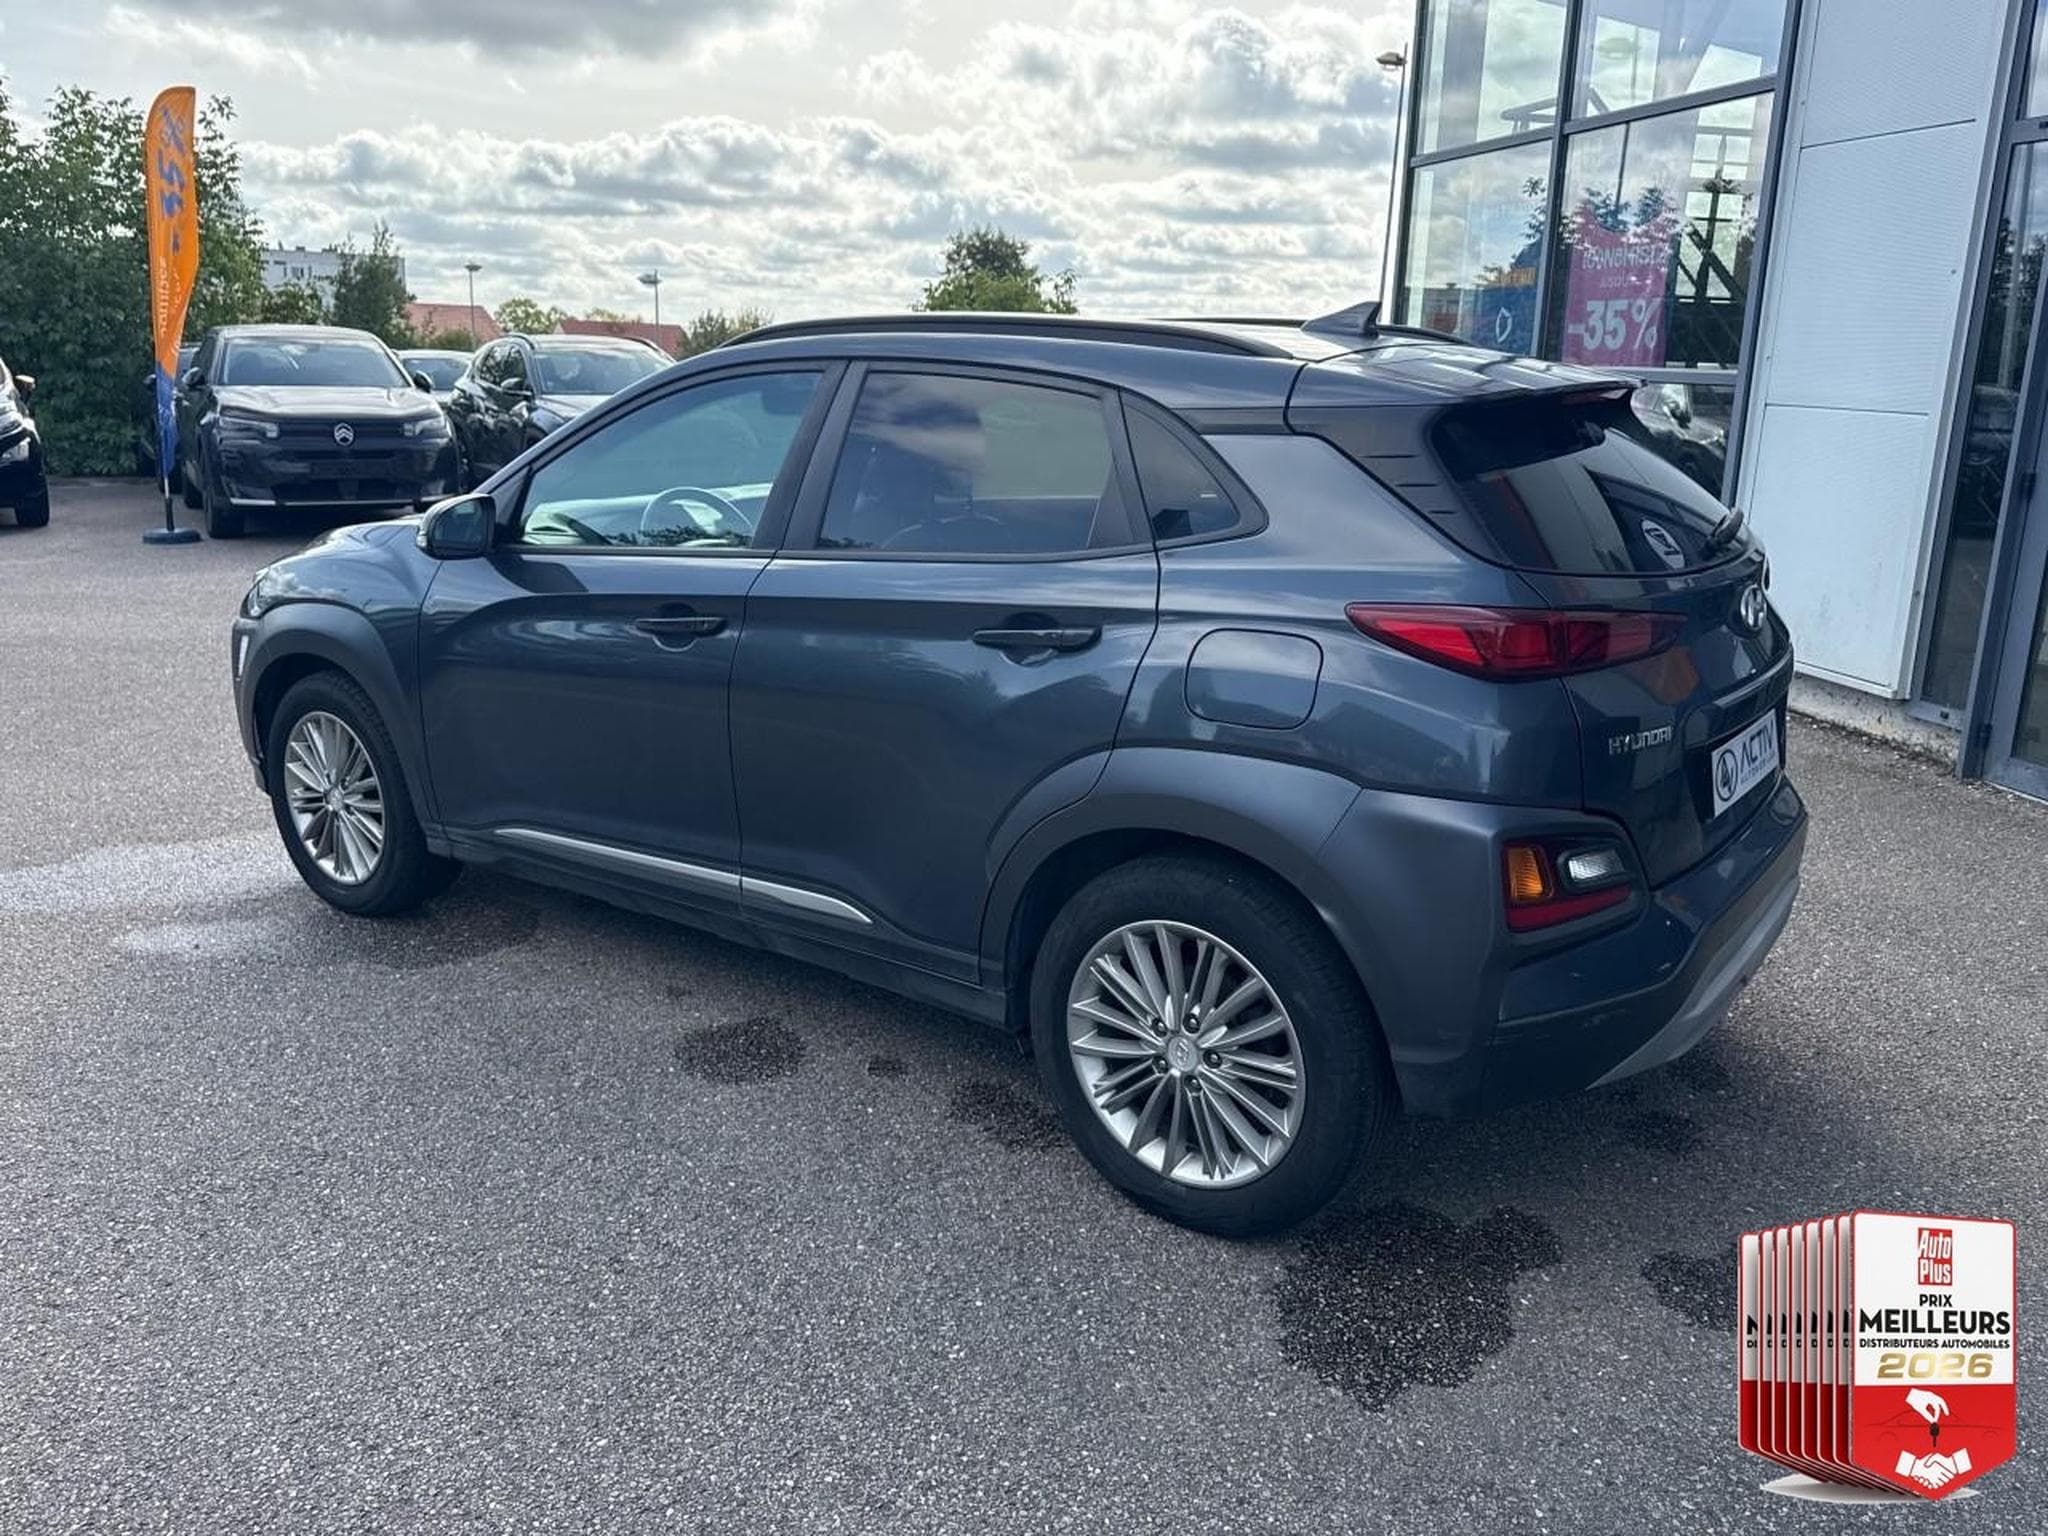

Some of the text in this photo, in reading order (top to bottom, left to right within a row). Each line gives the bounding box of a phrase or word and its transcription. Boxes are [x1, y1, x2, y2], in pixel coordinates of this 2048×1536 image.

[1567, 297, 1662, 351] -35%
[1608, 725, 1672, 755] HYUNDAI
[1740, 718, 1775, 773] ACTIV
